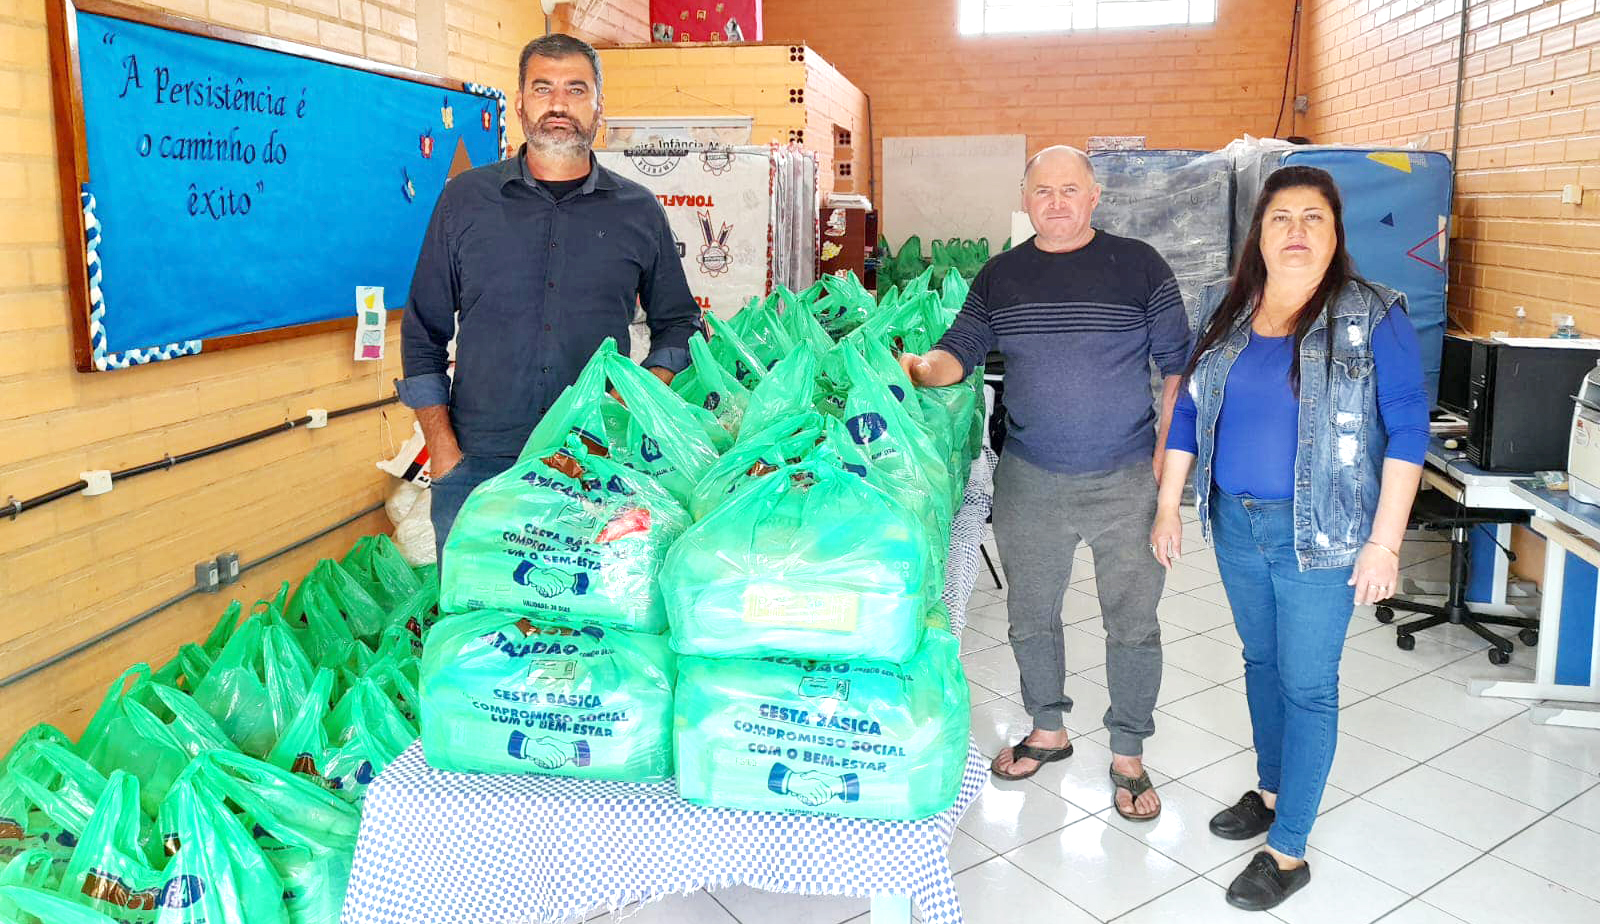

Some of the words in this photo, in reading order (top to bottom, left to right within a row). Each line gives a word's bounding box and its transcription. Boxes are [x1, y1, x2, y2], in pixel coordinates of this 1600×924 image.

[154, 66, 286, 116] Persistência
[296, 87, 307, 119] é
[160, 126, 256, 164] caminho
[262, 129, 287, 164] do
[656, 194, 715, 208] TORAFL
[493, 689, 541, 704] CESTA
[471, 701, 574, 723] COMPROMISSO
[578, 711, 630, 722] SOCIAL
[758, 703, 811, 725] CESTA
[539, 720, 614, 738] BEM-ESTAR
[733, 719, 847, 749] COMPROMISSO
[851, 740, 907, 757] SOCIAL
[748, 742, 782, 757] COM
[786, 748, 798, 760] O
[803, 750, 887, 773] BEM-ESTAR
